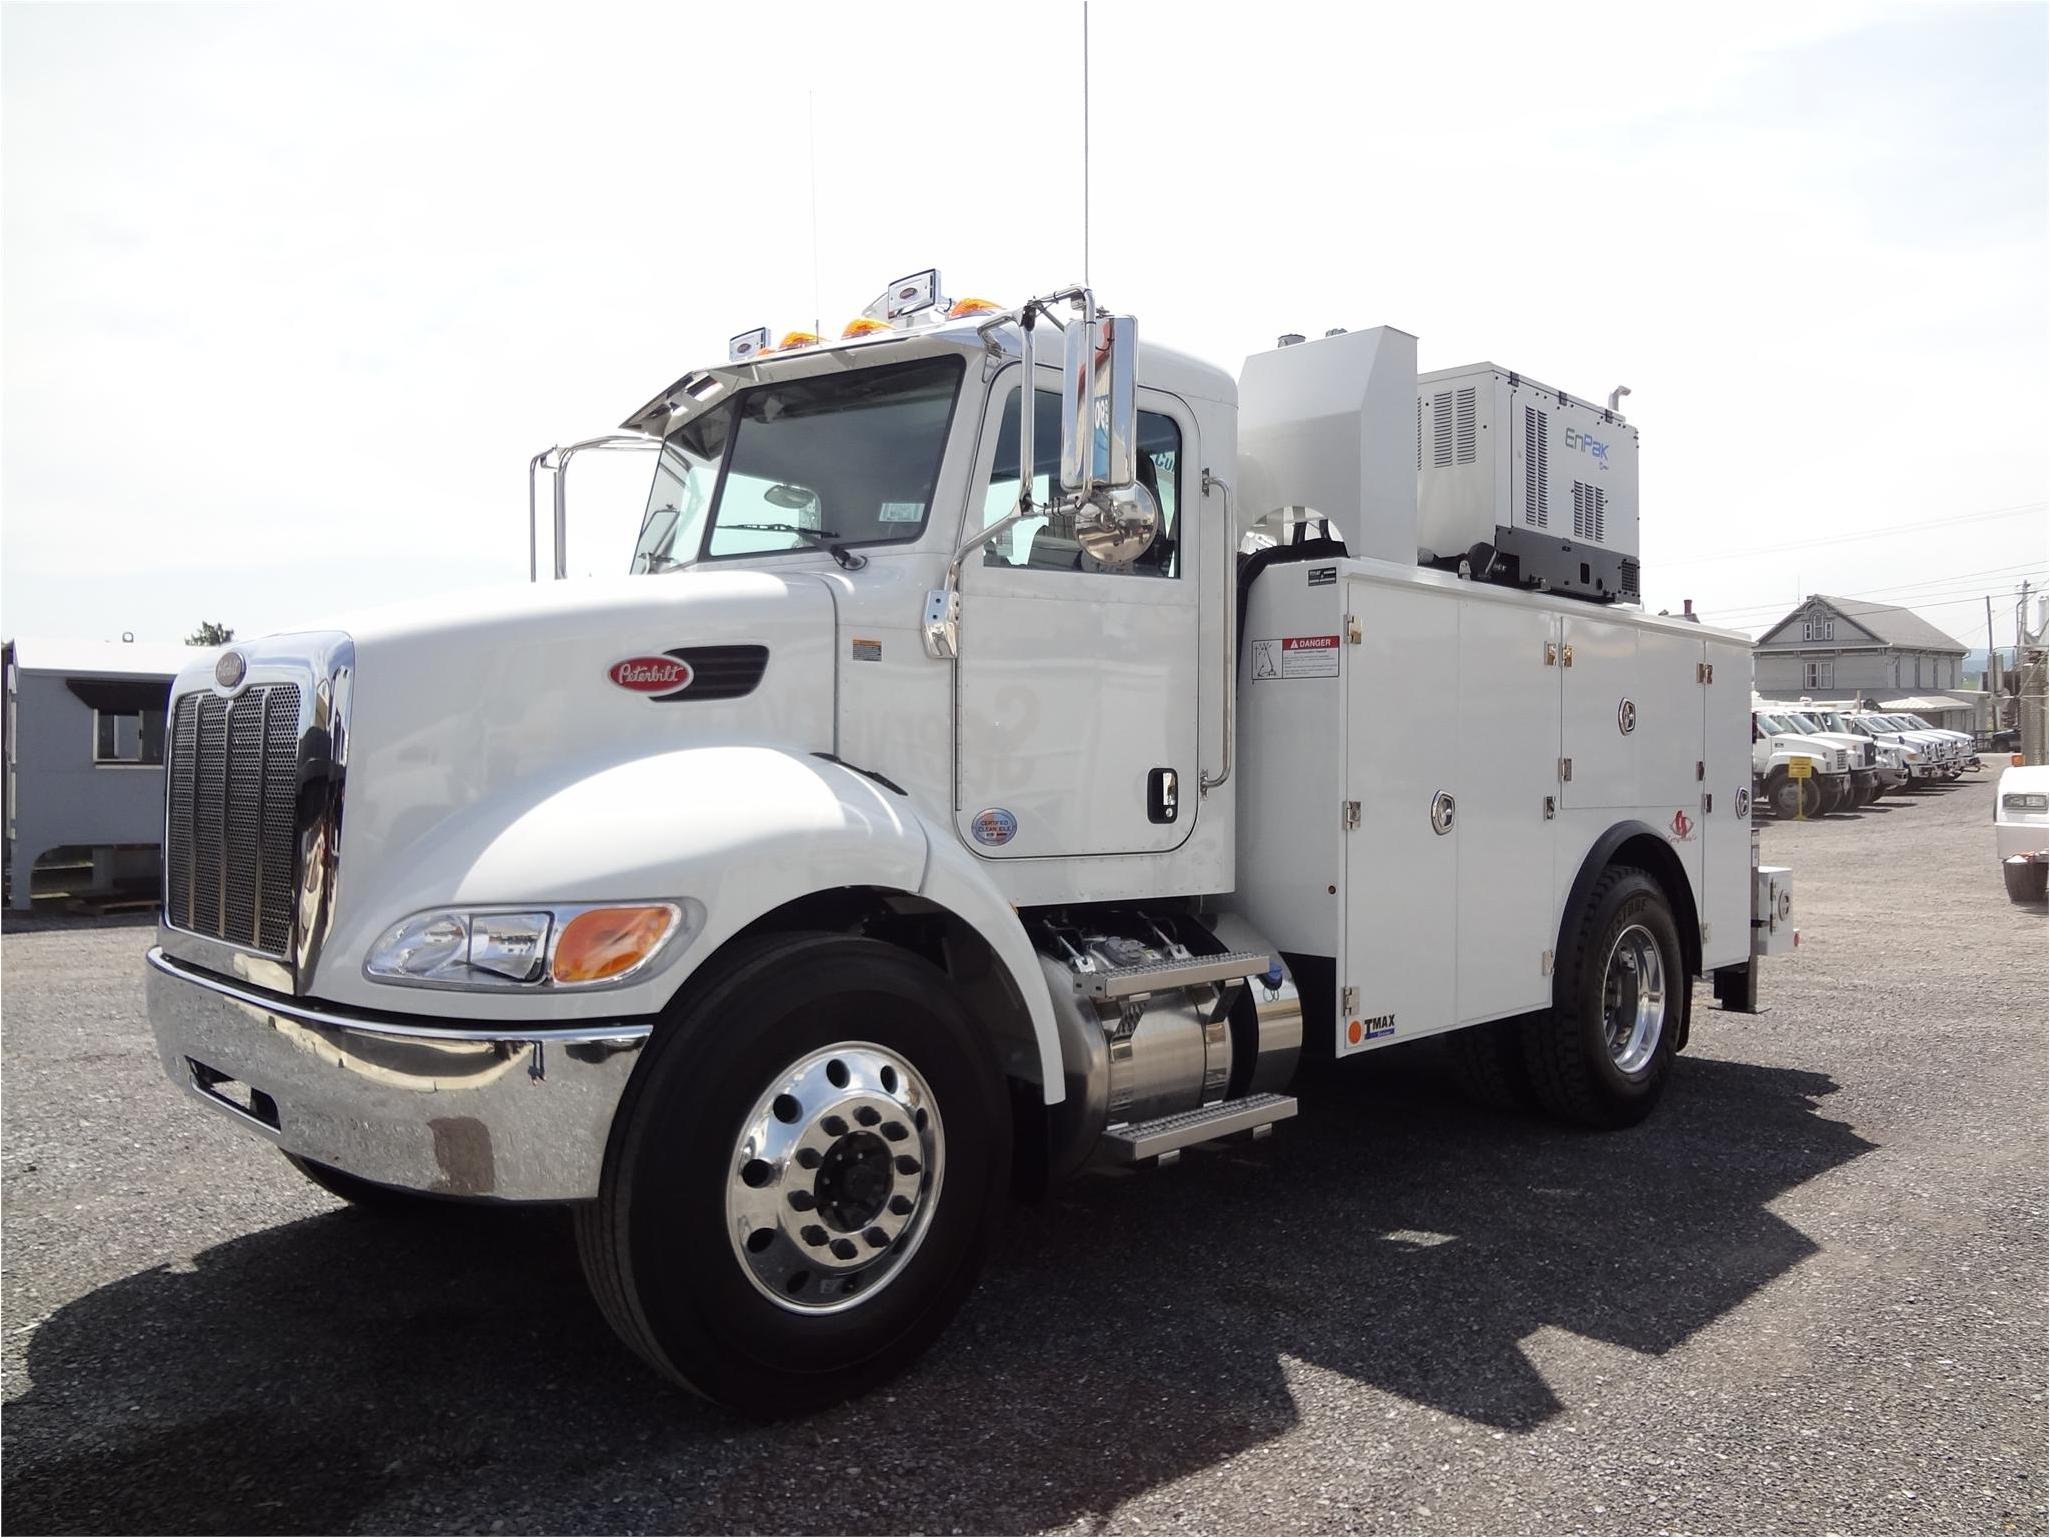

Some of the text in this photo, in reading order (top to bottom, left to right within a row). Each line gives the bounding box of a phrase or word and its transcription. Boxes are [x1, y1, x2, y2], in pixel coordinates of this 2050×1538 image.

[1300, 639, 1331, 648] DANGER
[619, 663, 684, 684] Peterbilt
[1364, 1014, 1395, 1040] TMAX
